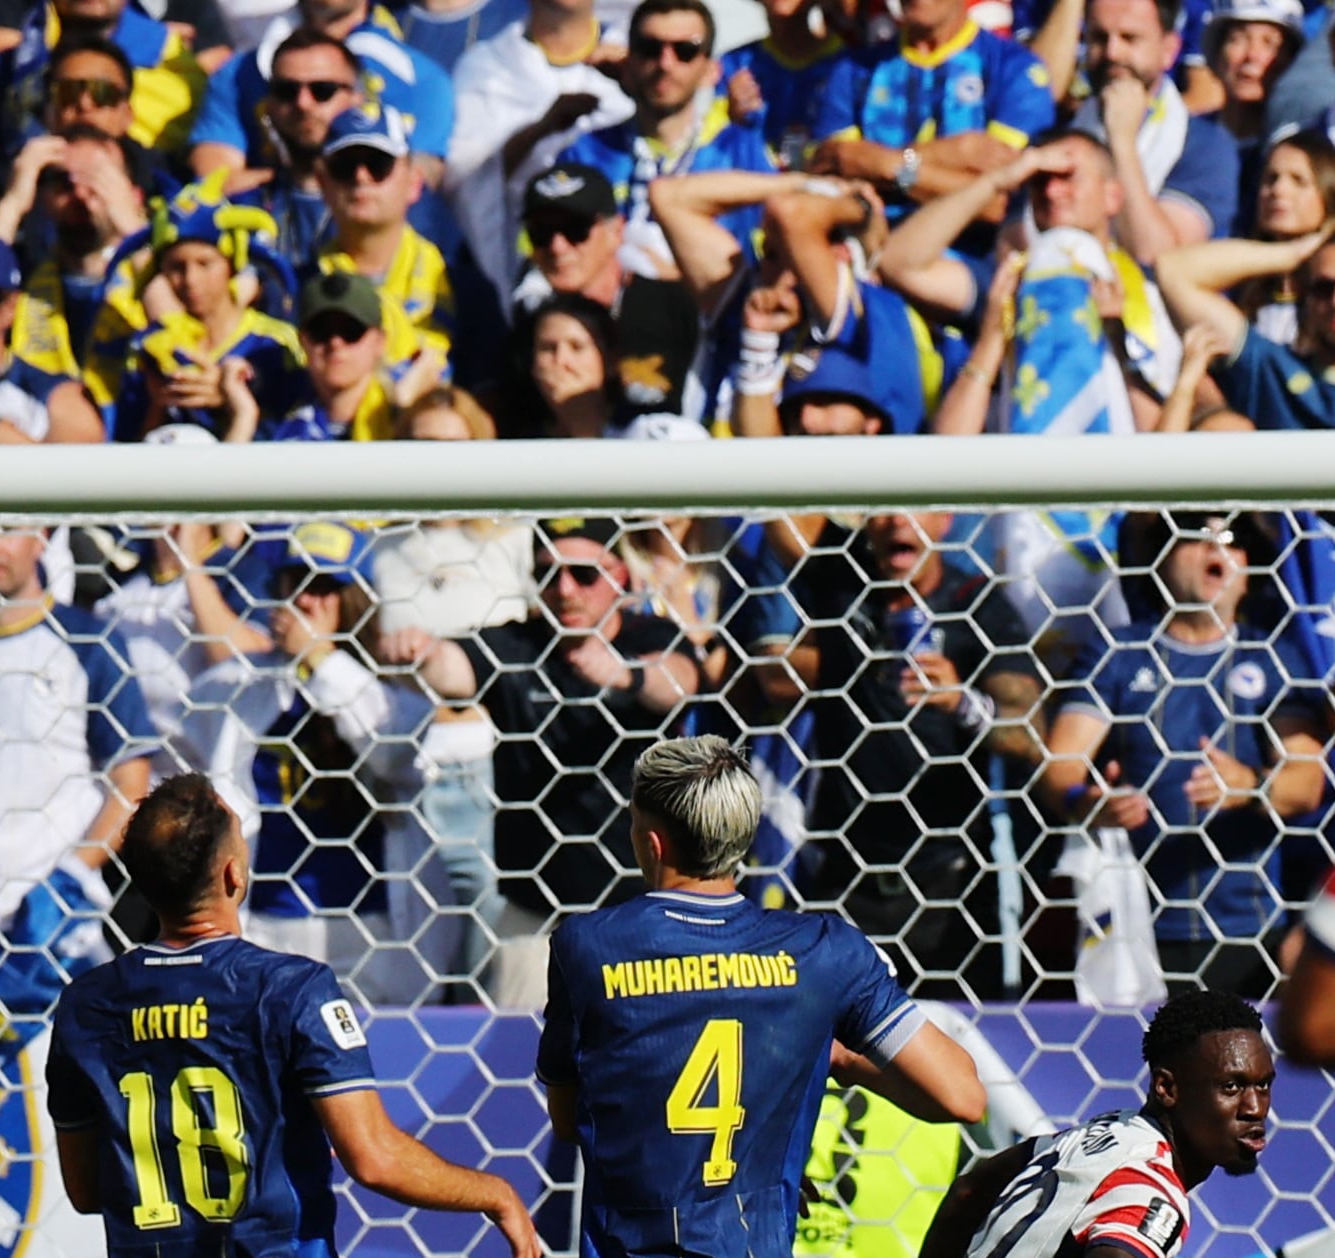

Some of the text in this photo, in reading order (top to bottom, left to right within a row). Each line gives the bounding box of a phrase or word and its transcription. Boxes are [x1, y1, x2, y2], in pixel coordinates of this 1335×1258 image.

[131, 997, 209, 1042] KATIĆ
[602, 950, 798, 1000] MUHAREMOVIĆ
[118, 1066, 249, 1231] 18
[666, 1018, 746, 1188] 4
